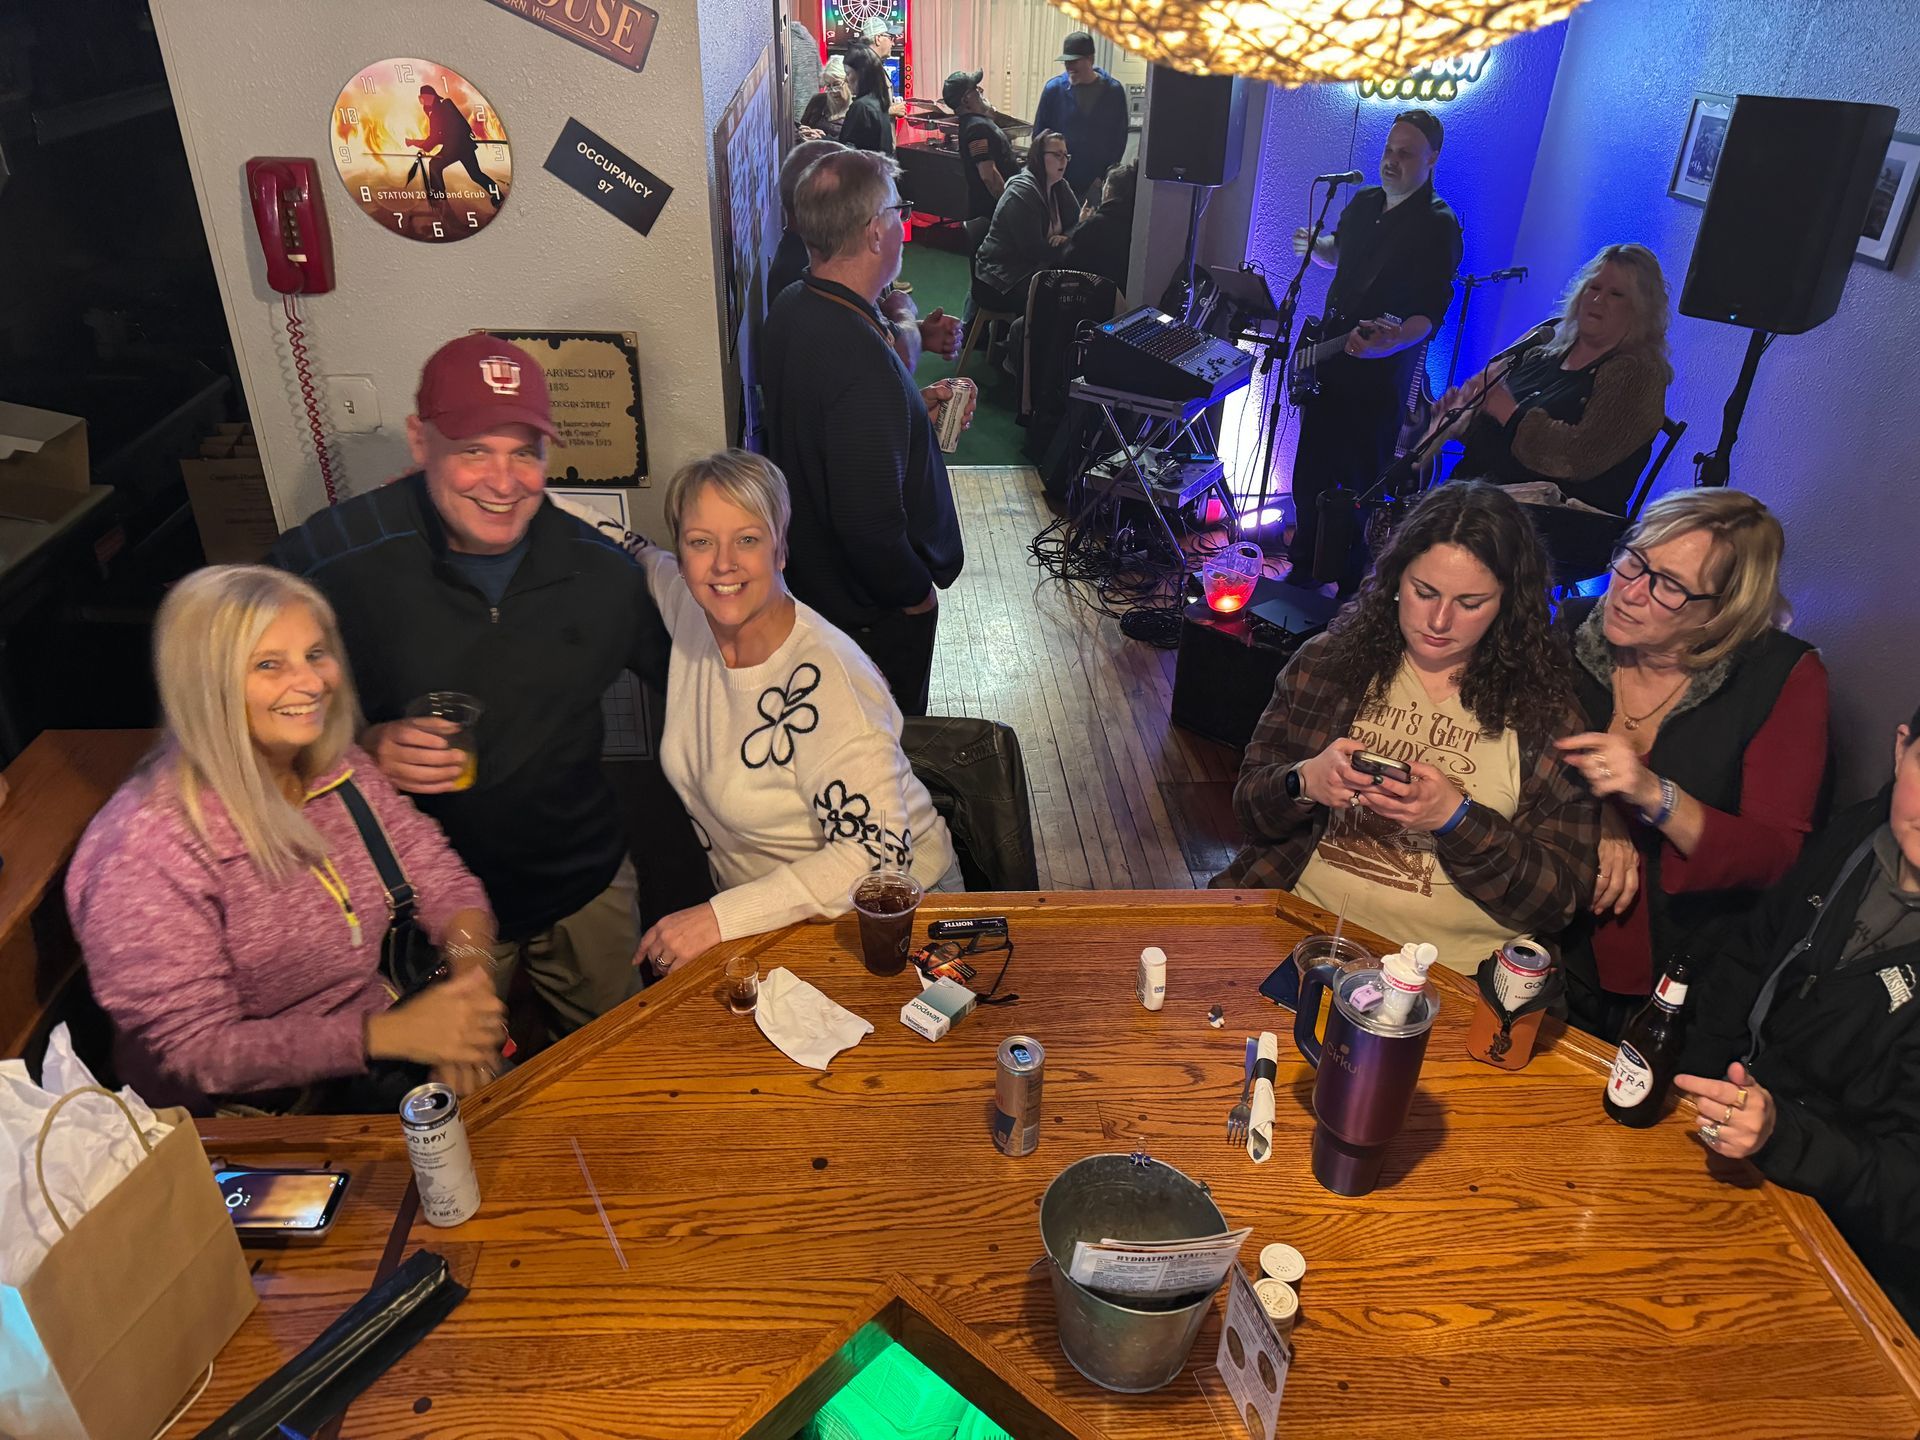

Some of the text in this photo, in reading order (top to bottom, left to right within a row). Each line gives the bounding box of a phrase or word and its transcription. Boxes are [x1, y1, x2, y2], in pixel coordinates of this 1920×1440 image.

[531, 5, 546, 21] WI
[536, 0, 642, 54] USE
[394, 64, 415, 83] 12
[360, 76, 376, 95] 11
[441, 76, 449, 93] 1
[339, 107, 359, 125] 10
[474, 104, 486, 122] 2
[339, 146, 352, 164] 9
[492, 144, 505, 162] 3
[576, 142, 653, 198] OCCUPANCY
[360, 186, 372, 202] 8
[377, 191, 415, 200] STATION
[415, 191, 427, 199] 20
[446, 190, 463, 199] and
[463, 190, 486, 199] Grub
[488, 184, 501, 200] 4
[597, 179, 614, 194] 97
[393, 212, 403, 228] 7
[466, 212, 478, 228] 5
[433, 222, 444, 238] 6
[543, 368, 616, 379] ARNESS SHOP
[580, 401, 610, 409] STREET
[1429, 712, 1479, 752] GET
[911, 1002, 942, 1024] Newport
[1614, 1062, 1646, 1090] LTRA
[1116, 1251, 1218, 1263] HYDRATION STATION
